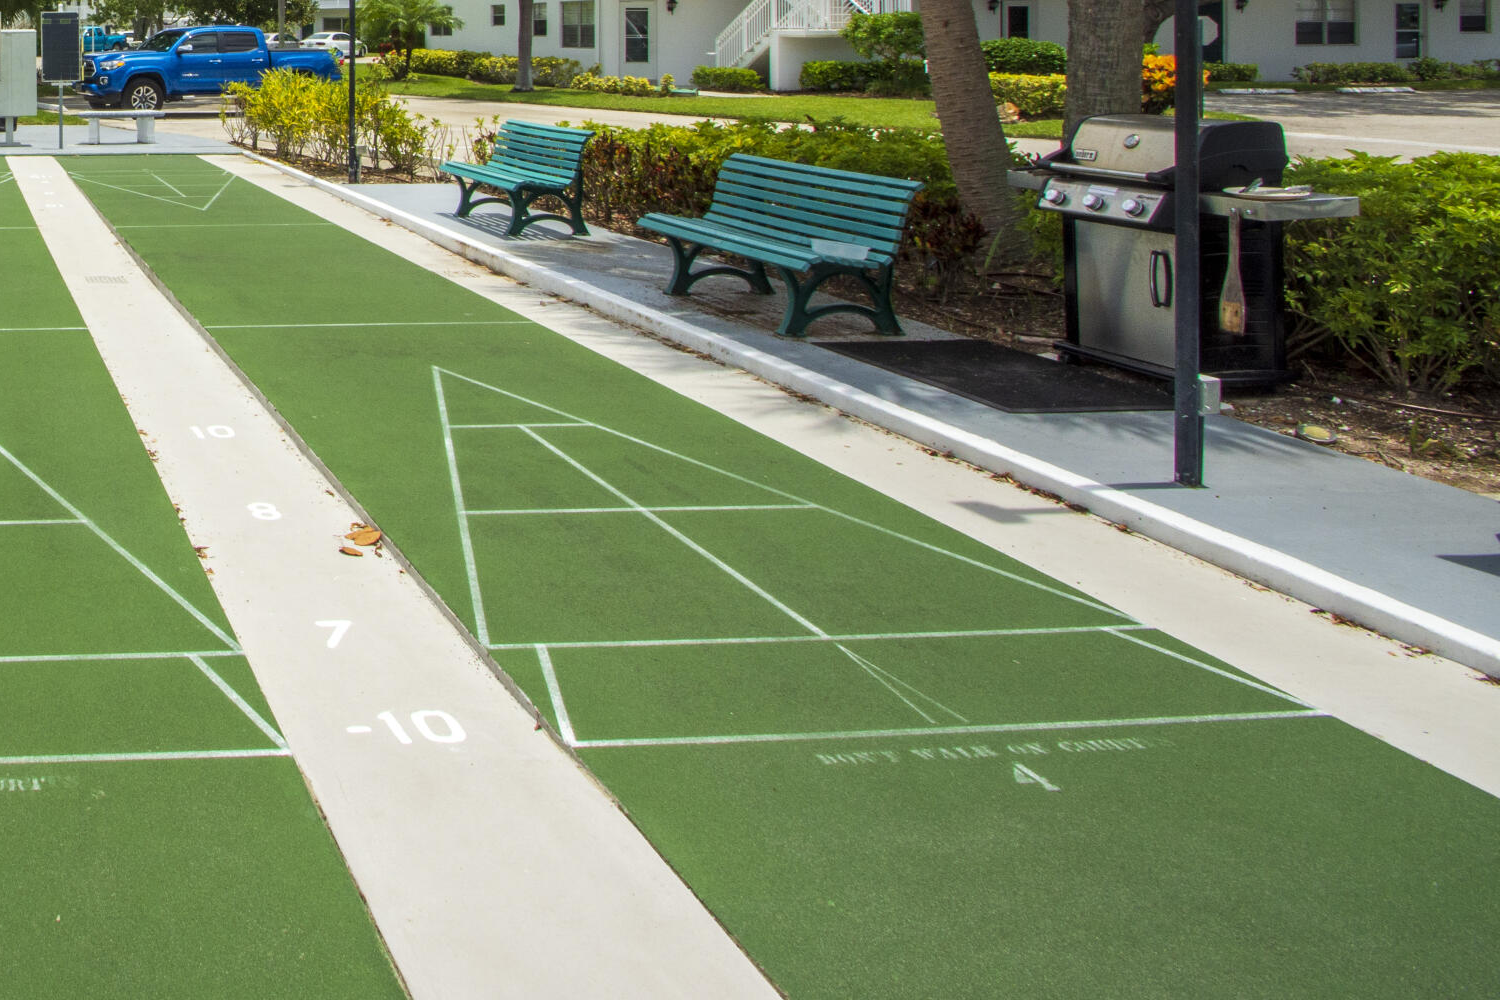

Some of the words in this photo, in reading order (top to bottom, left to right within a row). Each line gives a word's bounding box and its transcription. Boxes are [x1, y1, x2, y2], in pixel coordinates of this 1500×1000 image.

[189, 425, 235, 439] 10
[247, 502, 282, 520] 8
[314, 619, 353, 648] 7
[346, 710, 467, 744] -10
[910, 745, 997, 760] WALK
[1007, 742, 1049, 755] ON
[1013, 761, 1061, 792] 4
